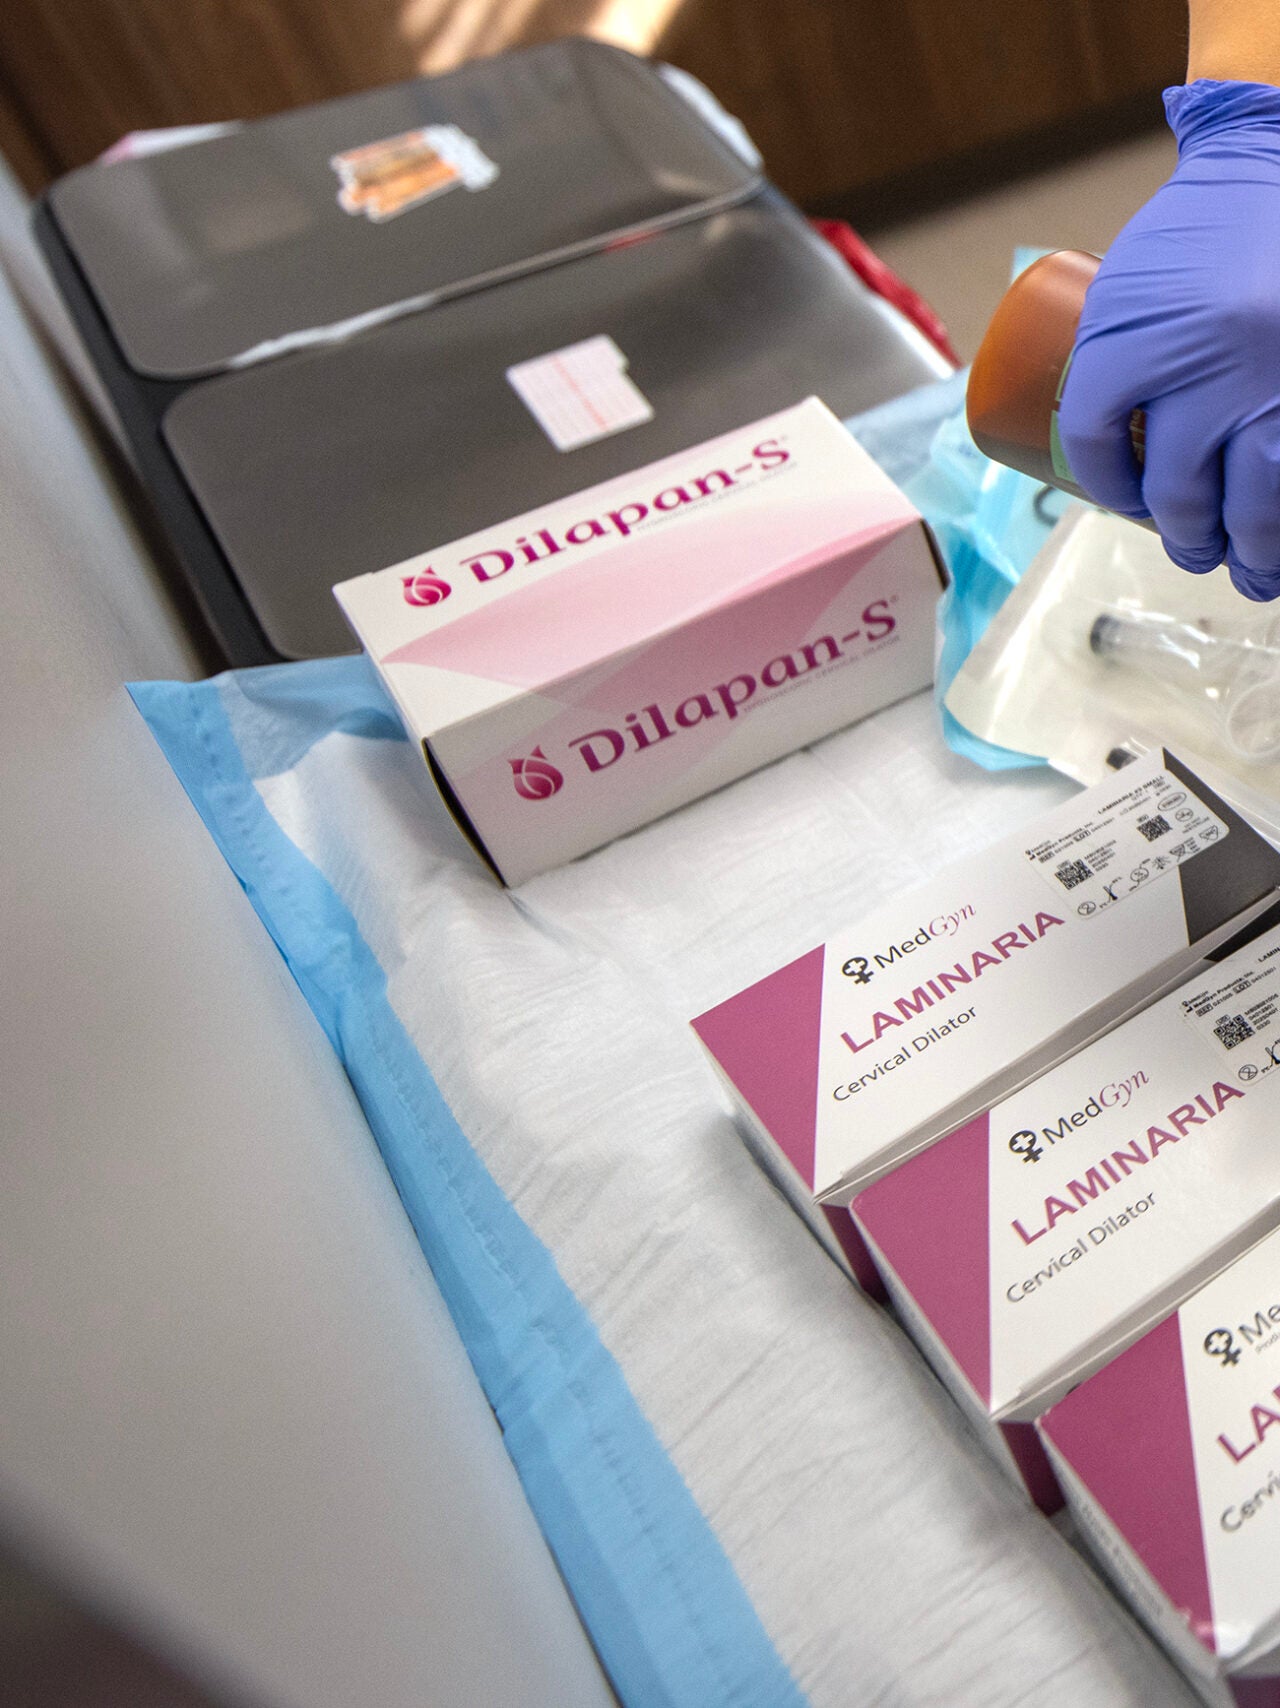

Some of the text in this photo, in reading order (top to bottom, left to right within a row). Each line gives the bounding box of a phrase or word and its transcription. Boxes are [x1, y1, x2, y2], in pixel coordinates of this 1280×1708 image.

[840, 910, 1065, 1054] LAMINARIA
[873, 902, 977, 970] MedGyn
[832, 1005, 978, 1103] Cervical Dilator
[1041, 1070, 1150, 1145] MedGyn
[1010, 1081, 1246, 1246] LAMINARIA
[1006, 1192, 1156, 1303] Cervical Dilator
